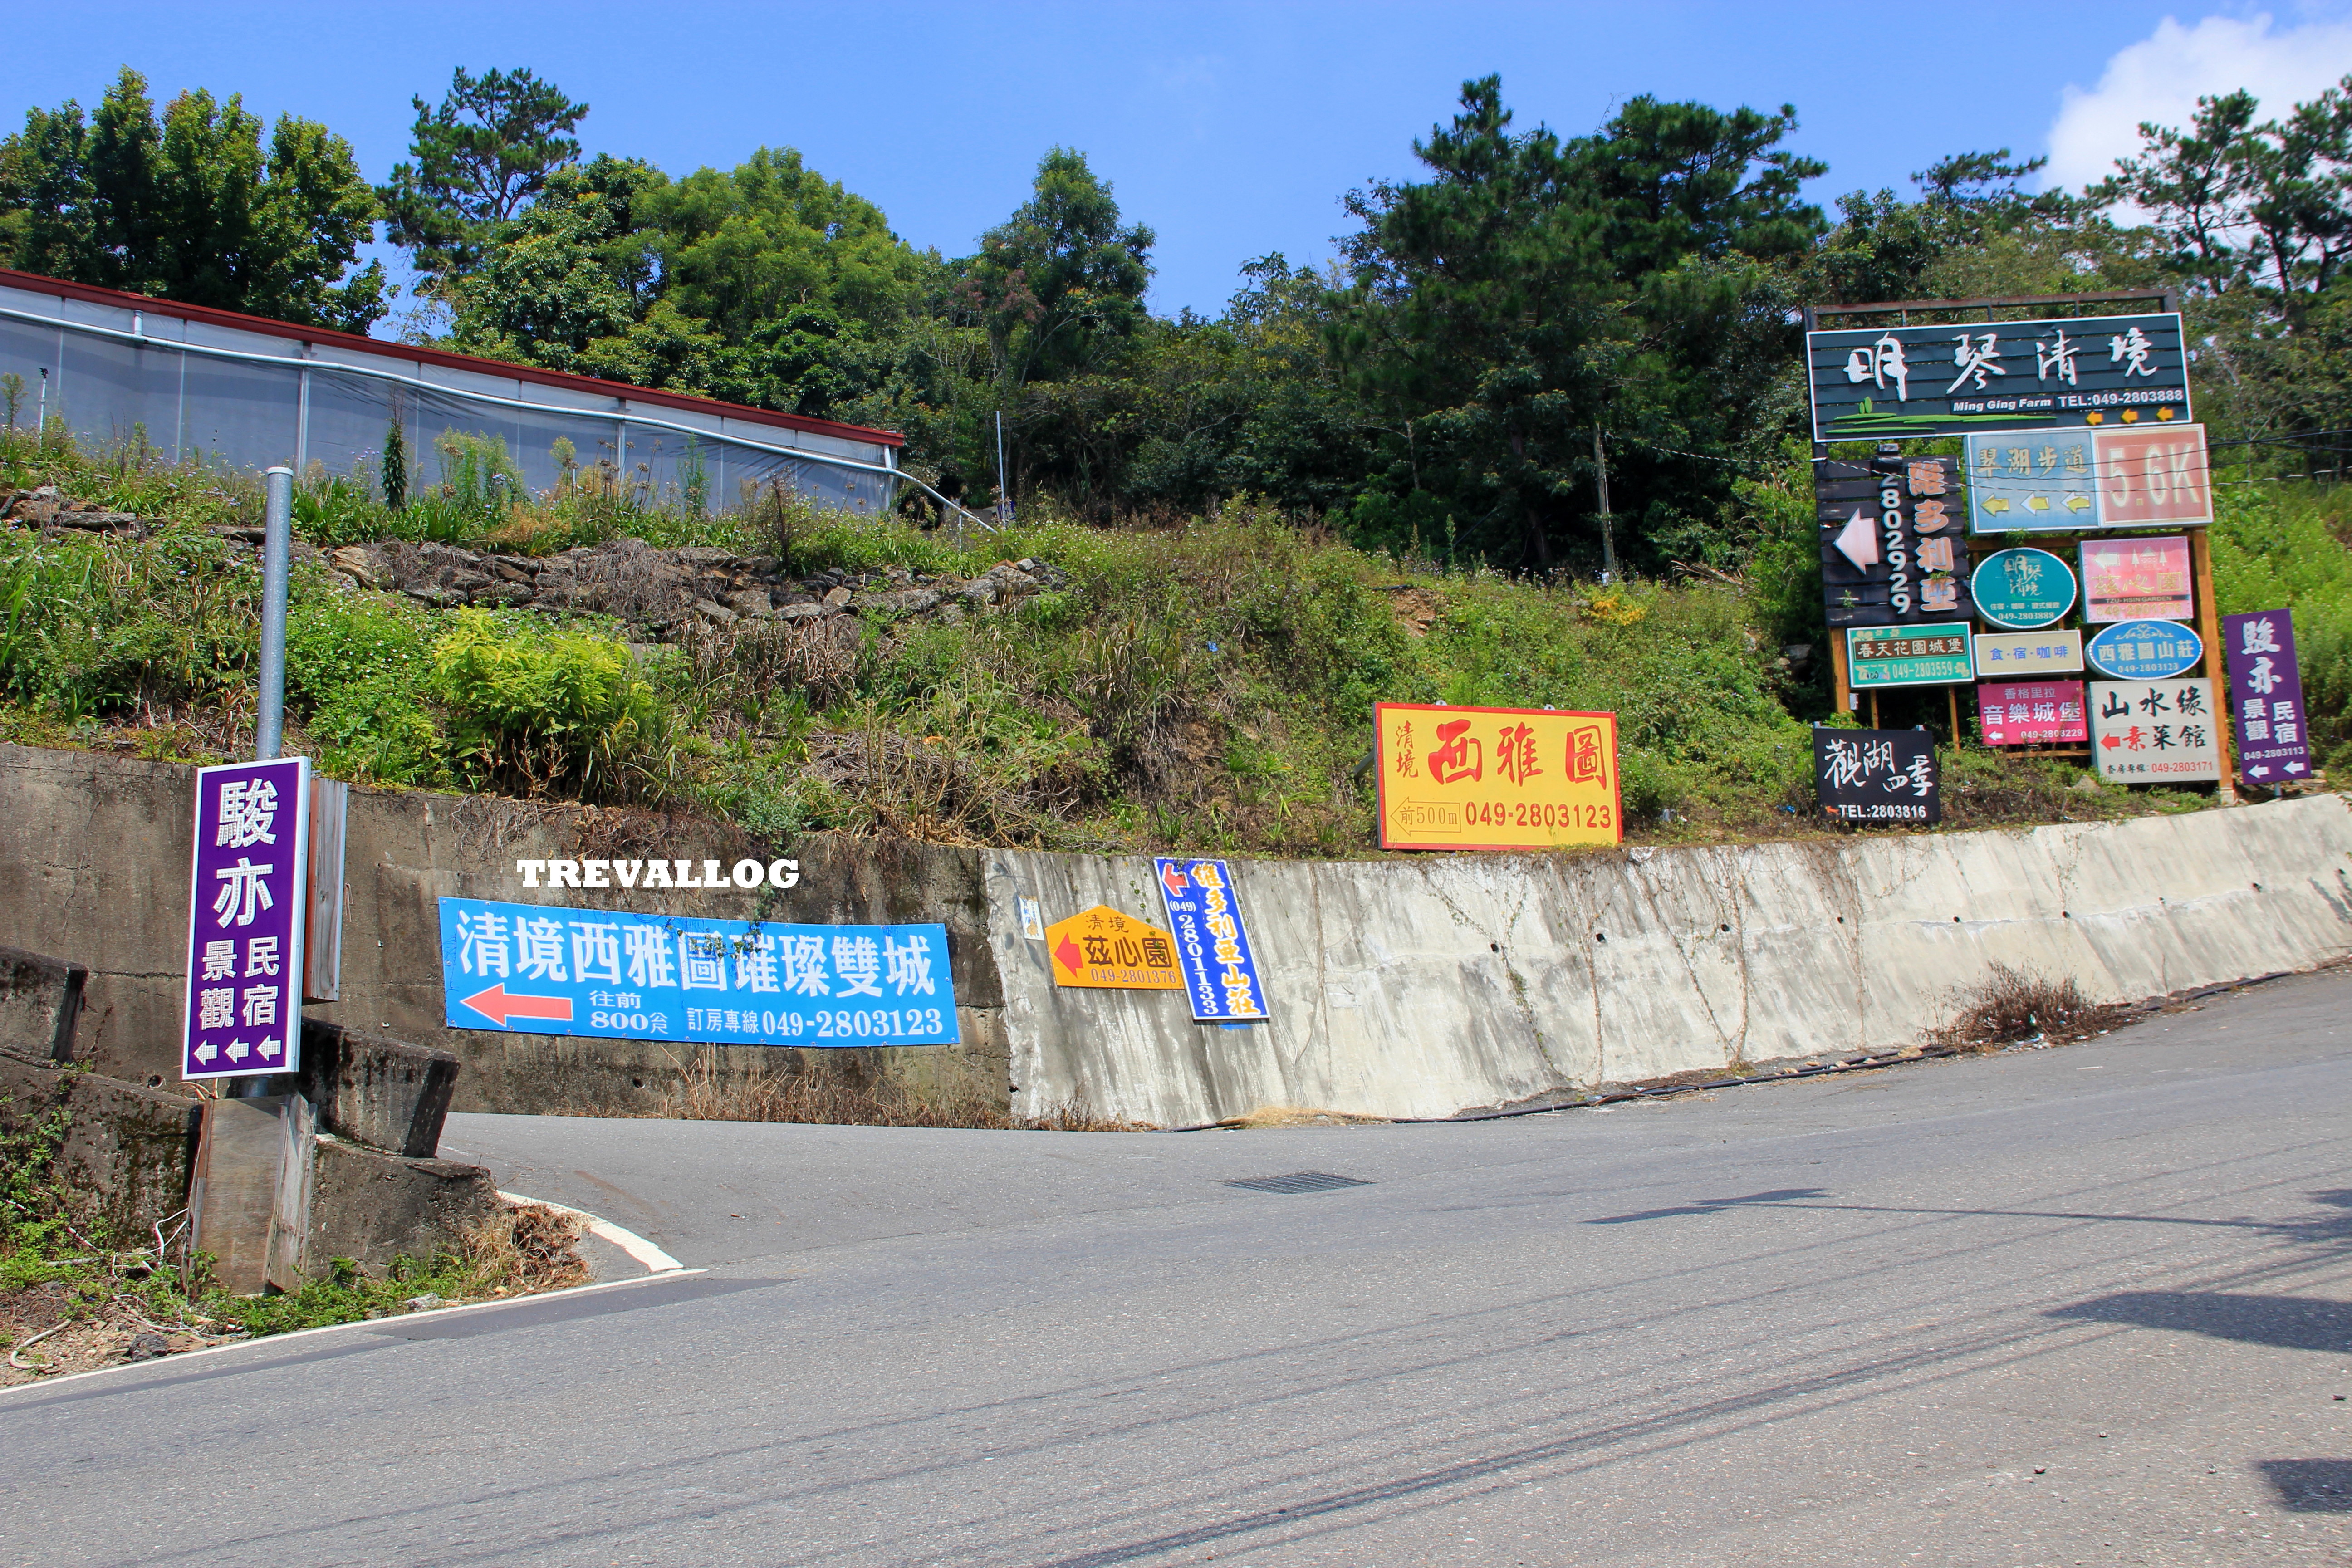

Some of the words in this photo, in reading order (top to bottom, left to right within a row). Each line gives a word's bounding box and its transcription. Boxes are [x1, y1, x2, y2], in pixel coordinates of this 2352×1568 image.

[1843, 327, 2158, 402] 明琴清境
[1953, 402, 1984, 412] Ming
[1987, 399, 2015, 411] Ging
[2018, 398, 2051, 407] Farm
[2058, 389, 2184, 407] TEL:049-2803888
[1976, 444, 2088, 480] 翠湖步道
[2109, 443, 2200, 508] 5.6K
[1880, 473, 1911, 614] 2802929
[1998, 612, 2055, 620] 049-2803888
[2096, 603, 2182, 616] 049-2801376
[1858, 638, 1964, 657] 春天花園城堡
[2097, 639, 2195, 662] 西雅圖山莊
[2241, 617, 2283, 694] 駿亦
[1892, 661, 1952, 678] 049-2803559
[2118, 662, 2179, 673] 049-2803123
[2004, 687, 2056, 699] 香格里拉
[2101, 686, 2207, 719] 山水緣
[1983, 702, 2082, 725] 音樂城堡
[2243, 698, 2269, 741] 景觀
[2273, 701, 2298, 744] 民宿
[2021, 729, 2083, 739] 049-2803229
[2122, 724, 2206, 752] 素菜館
[1396, 720, 1419, 778] 清境
[1428, 719, 1607, 790] 西雅圖
[2244, 746, 2304, 760] 049-2803113
[2151, 761, 2213, 773] 049-2803171
[1400, 806, 1458, 826] 前500m
[1465, 801, 1611, 829] 049-2803123
[1839, 804, 1926, 818] TEL:2803816
[213, 778, 279, 929] 駿亦
[1170, 900, 1196, 912] (049)
[1085, 914, 1129, 933] 清境
[456, 910, 936, 998] 清境西雅圖璀璨雙城
[200, 939, 238, 1030] 景觀
[242, 936, 280, 1027] 民宿
[1091, 968, 1176, 984] 049-2801376
[589, 990, 642, 1009] 往前
[686, 1007, 760, 1034] 訂房專線
[762, 1008, 943, 1037] 049-2803123
